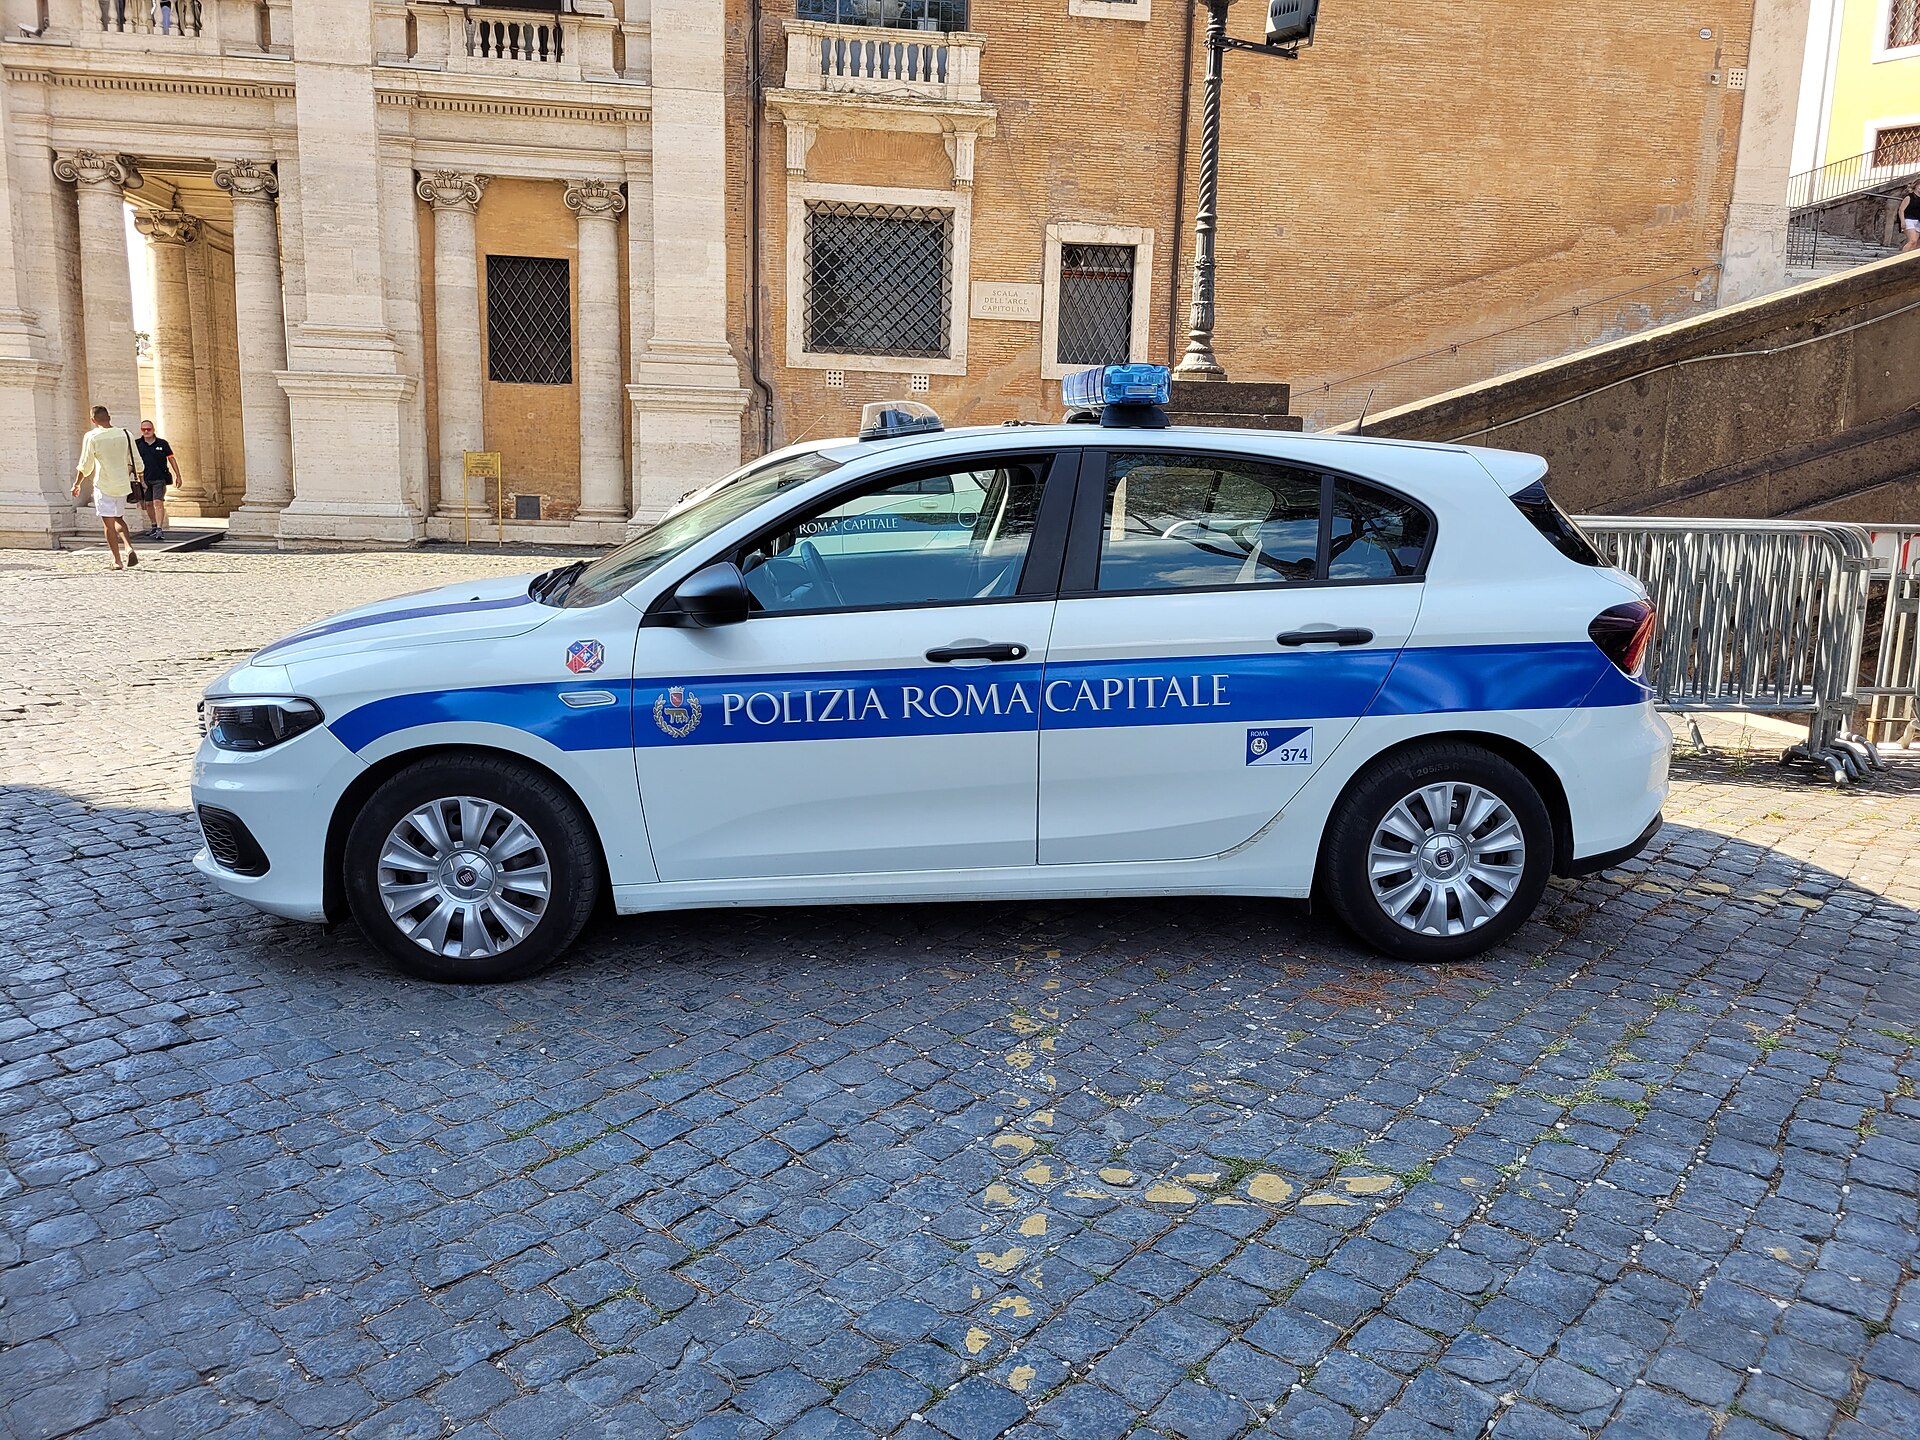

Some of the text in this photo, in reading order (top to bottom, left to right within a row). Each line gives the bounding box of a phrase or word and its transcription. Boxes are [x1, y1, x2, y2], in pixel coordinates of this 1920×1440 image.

[984, 297, 1028, 305] DELL'ARCE
[982, 305, 1030, 313] CAPITOLINA
[799, 516, 899, 535] ROMA CAPITALE
[721, 673, 1232, 726] POLIZIA ROMA CAPITALE
[1280, 748, 1308, 762] 374
[460, 872, 473, 884] FIAT
